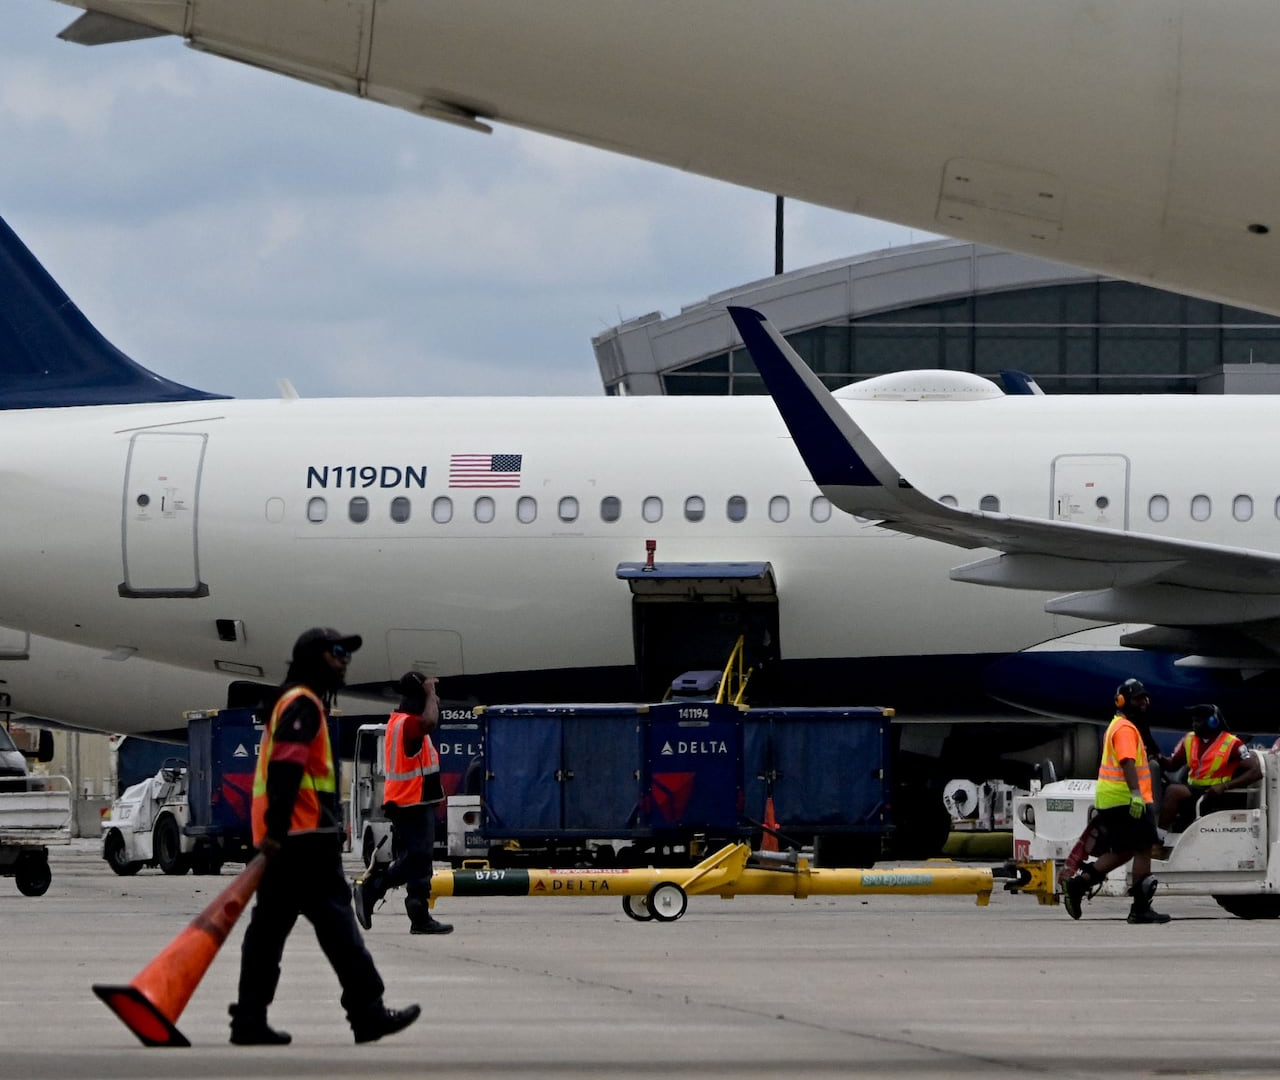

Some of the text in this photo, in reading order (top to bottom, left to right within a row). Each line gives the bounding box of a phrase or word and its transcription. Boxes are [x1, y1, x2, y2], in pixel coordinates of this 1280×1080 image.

[306, 465, 427, 489] N119DN
[678, 708, 709, 719] 141194
[678, 741, 728, 753] DELTA
[475, 870, 506, 881] B737
[552, 879, 610, 892] DELTA
